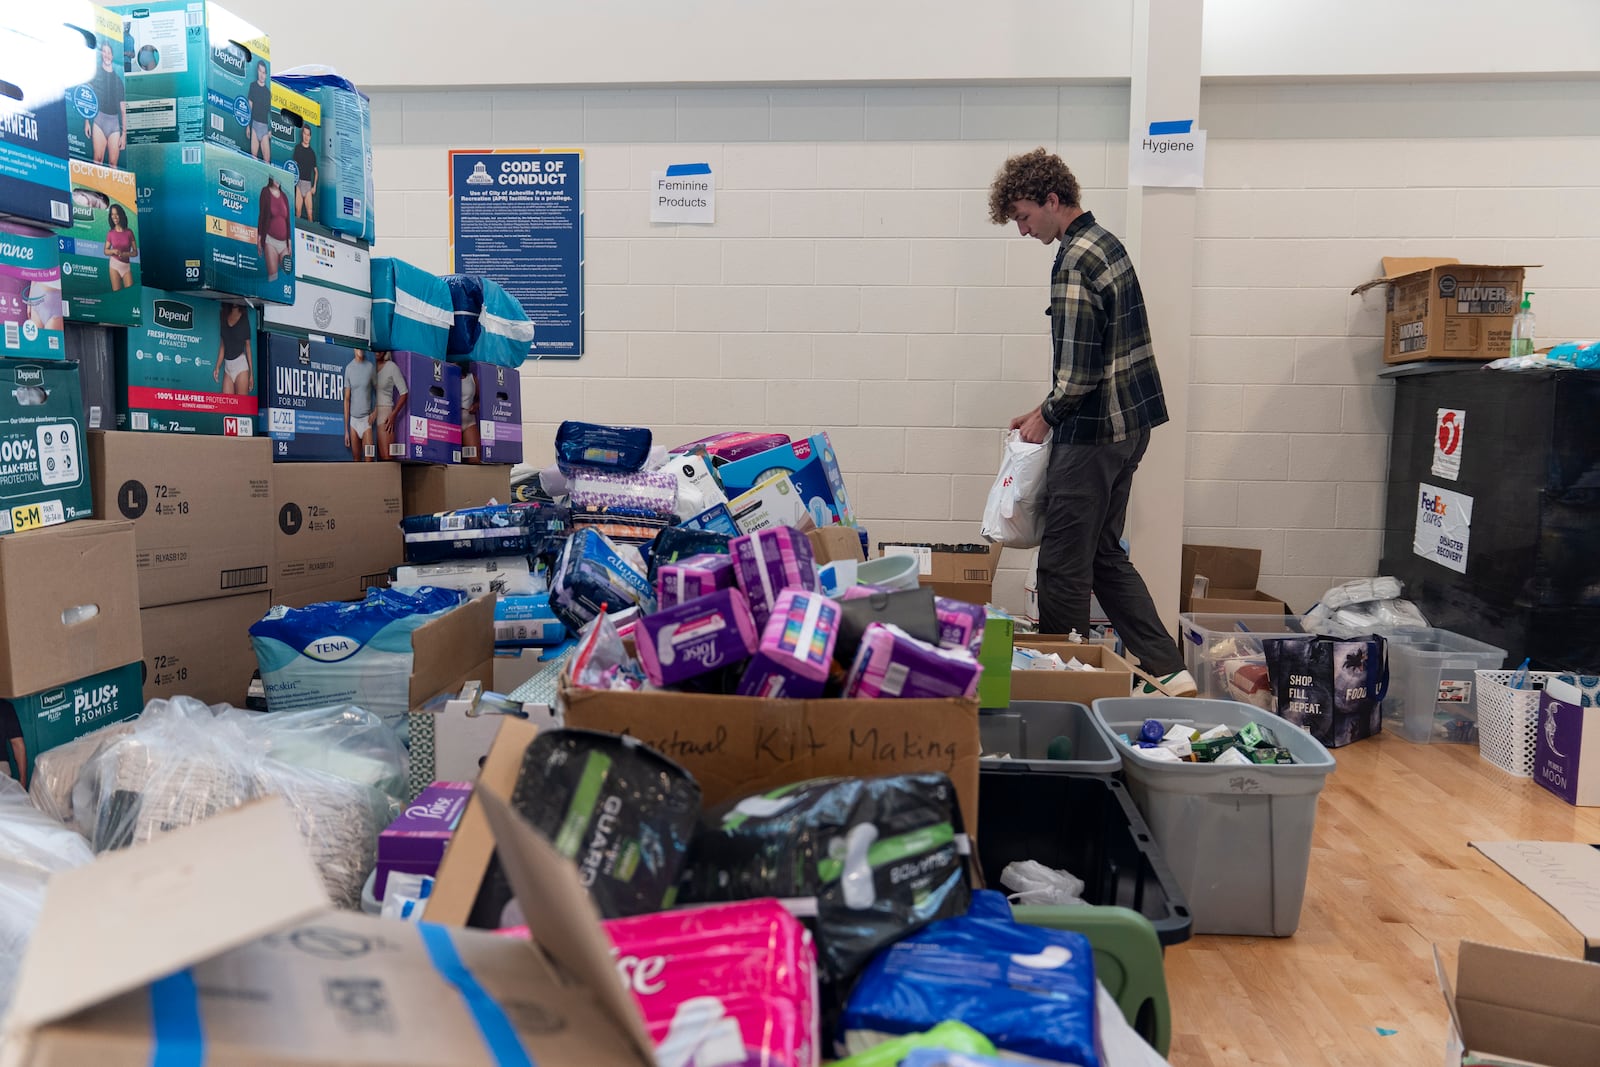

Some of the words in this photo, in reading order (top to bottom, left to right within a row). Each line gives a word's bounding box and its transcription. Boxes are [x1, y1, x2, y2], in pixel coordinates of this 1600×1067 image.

[214, 47, 243, 68] Depend
[1142, 138, 1194, 153] Hygiene
[500, 161, 541, 173] CODE
[544, 160, 564, 173] OF
[97, 167, 110, 180] UP
[112, 173, 135, 187] PACK
[221, 173, 244, 187] Depend
[498, 173, 567, 185] CONDUCT
[658, 179, 708, 191] Feminine
[217, 189, 249, 203] PROTECTION
[658, 196, 707, 208] Products
[222, 198, 244, 210] PLUS+
[212, 218, 223, 231] XL
[59, 239, 65, 250] S
[186, 268, 200, 278] 80
[1457, 286, 1506, 301] MOVER
[158, 307, 191, 322] Depend
[1488, 301, 1513, 314] one
[25, 325, 35, 333] 54
[1400, 321, 1424, 339] MOVER
[147, 330, 165, 339] FRESH
[165, 332, 200, 344] PROTECTION
[158, 340, 188, 348] ADVANCED
[17, 370, 40, 382] Depend
[276, 366, 344, 401] UNDERWEAR
[157, 392, 173, 401] 100%
[205, 396, 239, 405] PROTECTION
[278, 397, 291, 406] FOR
[293, 398, 306, 407] MEN
[273, 411, 293, 424] L/XL
[169, 421, 179, 431] 72
[226, 419, 237, 433] M
[0, 439, 37, 462] 00%
[279, 441, 288, 452] 84
[0, 472, 39, 486] PROTECTION
[154, 485, 168, 498] 72
[127, 490, 139, 509] L
[1421, 491, 1447, 516] FedEx
[66, 506, 76, 519] 76
[155, 502, 162, 516] 4
[177, 501, 189, 514] 18
[308, 505, 319, 517] 72
[14, 507, 40, 528] S-M
[743, 511, 769, 528] Organic
[308, 520, 315, 531] 4
[325, 519, 336, 530] 18
[747, 519, 770, 534] Cotton
[1439, 535, 1464, 552] DISASTER
[1436, 545, 1463, 563] RECOVERY
[314, 640, 349, 654] TENA
[682, 639, 725, 668] Poise
[154, 655, 167, 669] 72
[154, 673, 161, 686] 4
[176, 667, 188, 681] 18
[1289, 674, 1314, 687] SHOP.
[44, 691, 64, 704] Depend
[73, 687, 84, 695] THE
[1289, 687, 1309, 699] FILL.
[1345, 687, 1367, 701] FOOD
[74, 684, 119, 715] PLUS+
[75, 701, 119, 726] PROMISE
[1289, 701, 1322, 715] REPEAT.
[754, 725, 825, 761] Kit
[848, 727, 958, 769] Making
[1542, 766, 1567, 790] MOON
[579, 795, 622, 893] GUARD
